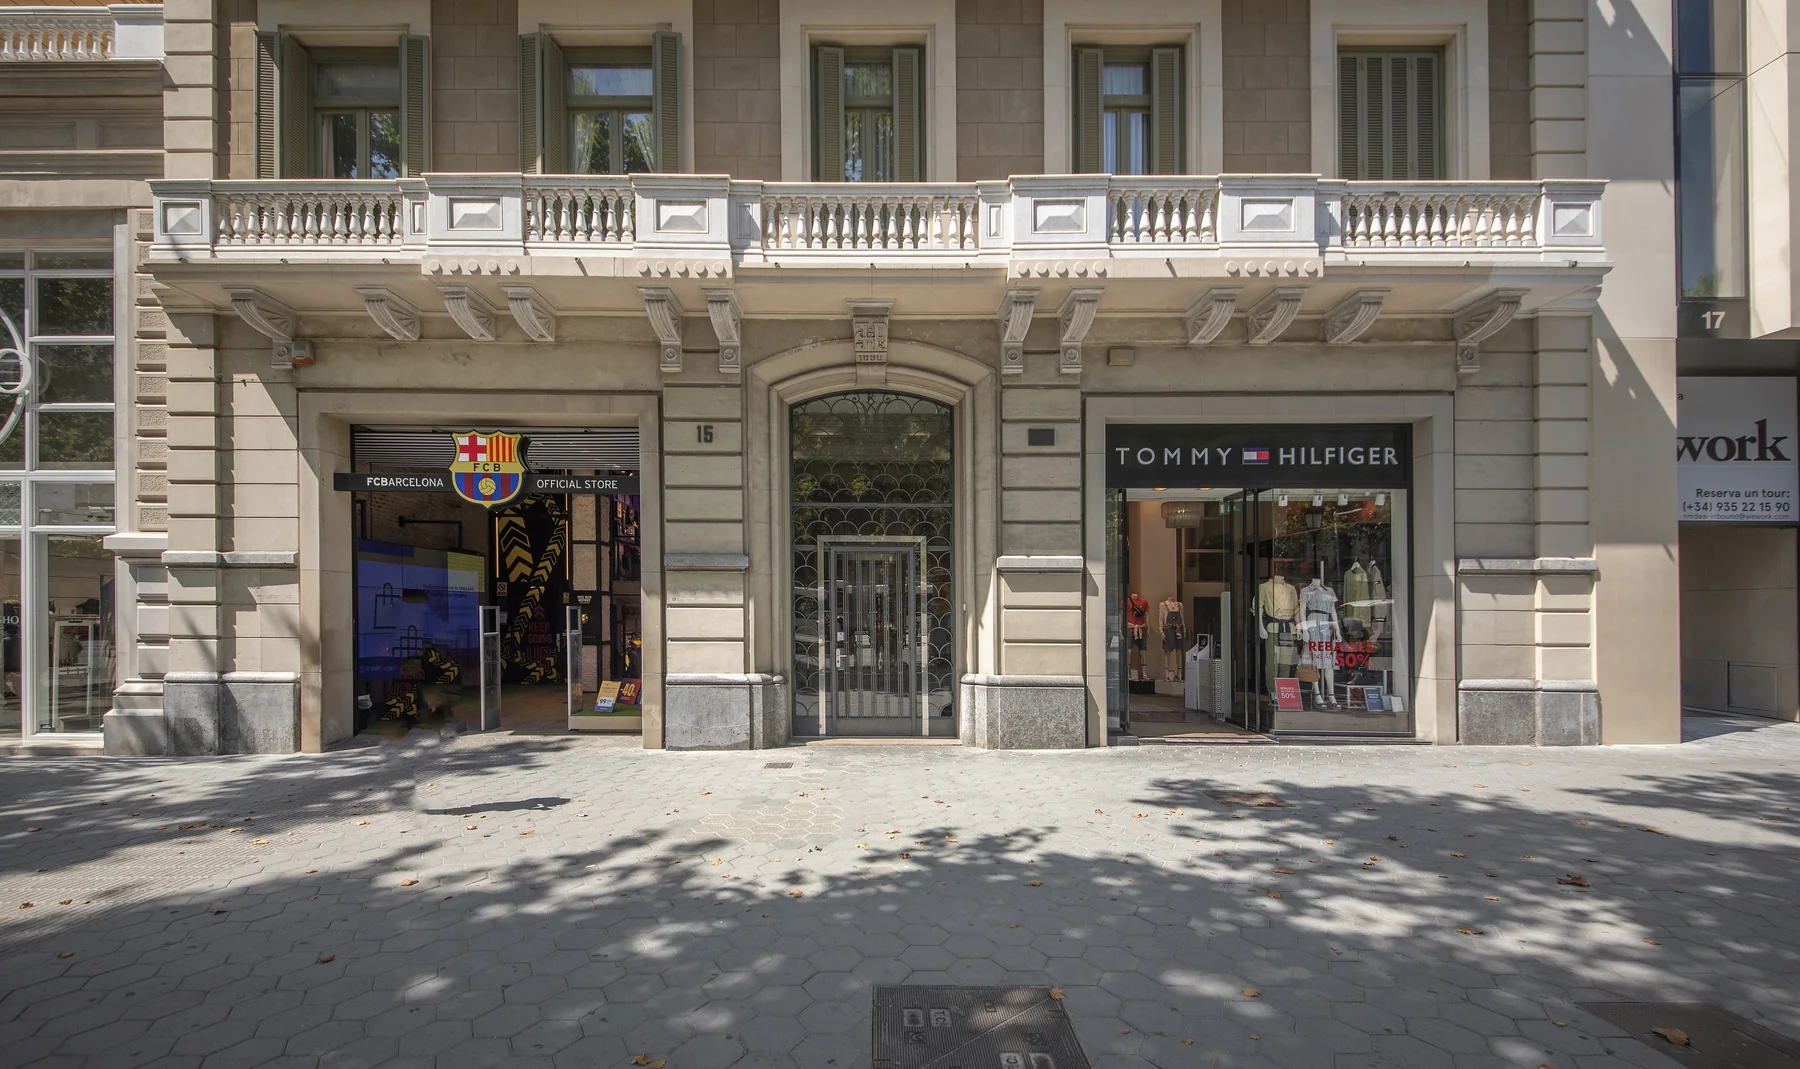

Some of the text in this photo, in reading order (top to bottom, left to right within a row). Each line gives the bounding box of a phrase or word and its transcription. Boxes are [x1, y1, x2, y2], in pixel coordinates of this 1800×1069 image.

[1701, 311, 1726, 330] 17
[696, 425, 714, 443] 15
[1115, 446, 1399, 466] TOMMY HILFIGER
[473, 463, 501, 472] FCB
[366, 477, 444, 488] FCBARCELONA
[536, 480, 618, 489] OFFICIAL STORE
[1696, 488, 1790, 498] Reserva un tour:
[1682, 501, 1790, 512] (+34) 935 22 15 90
[528, 622, 549, 631] KEEP
[528, 633, 552, 644] GOING
[1335, 653, 1373, 667] 50%
